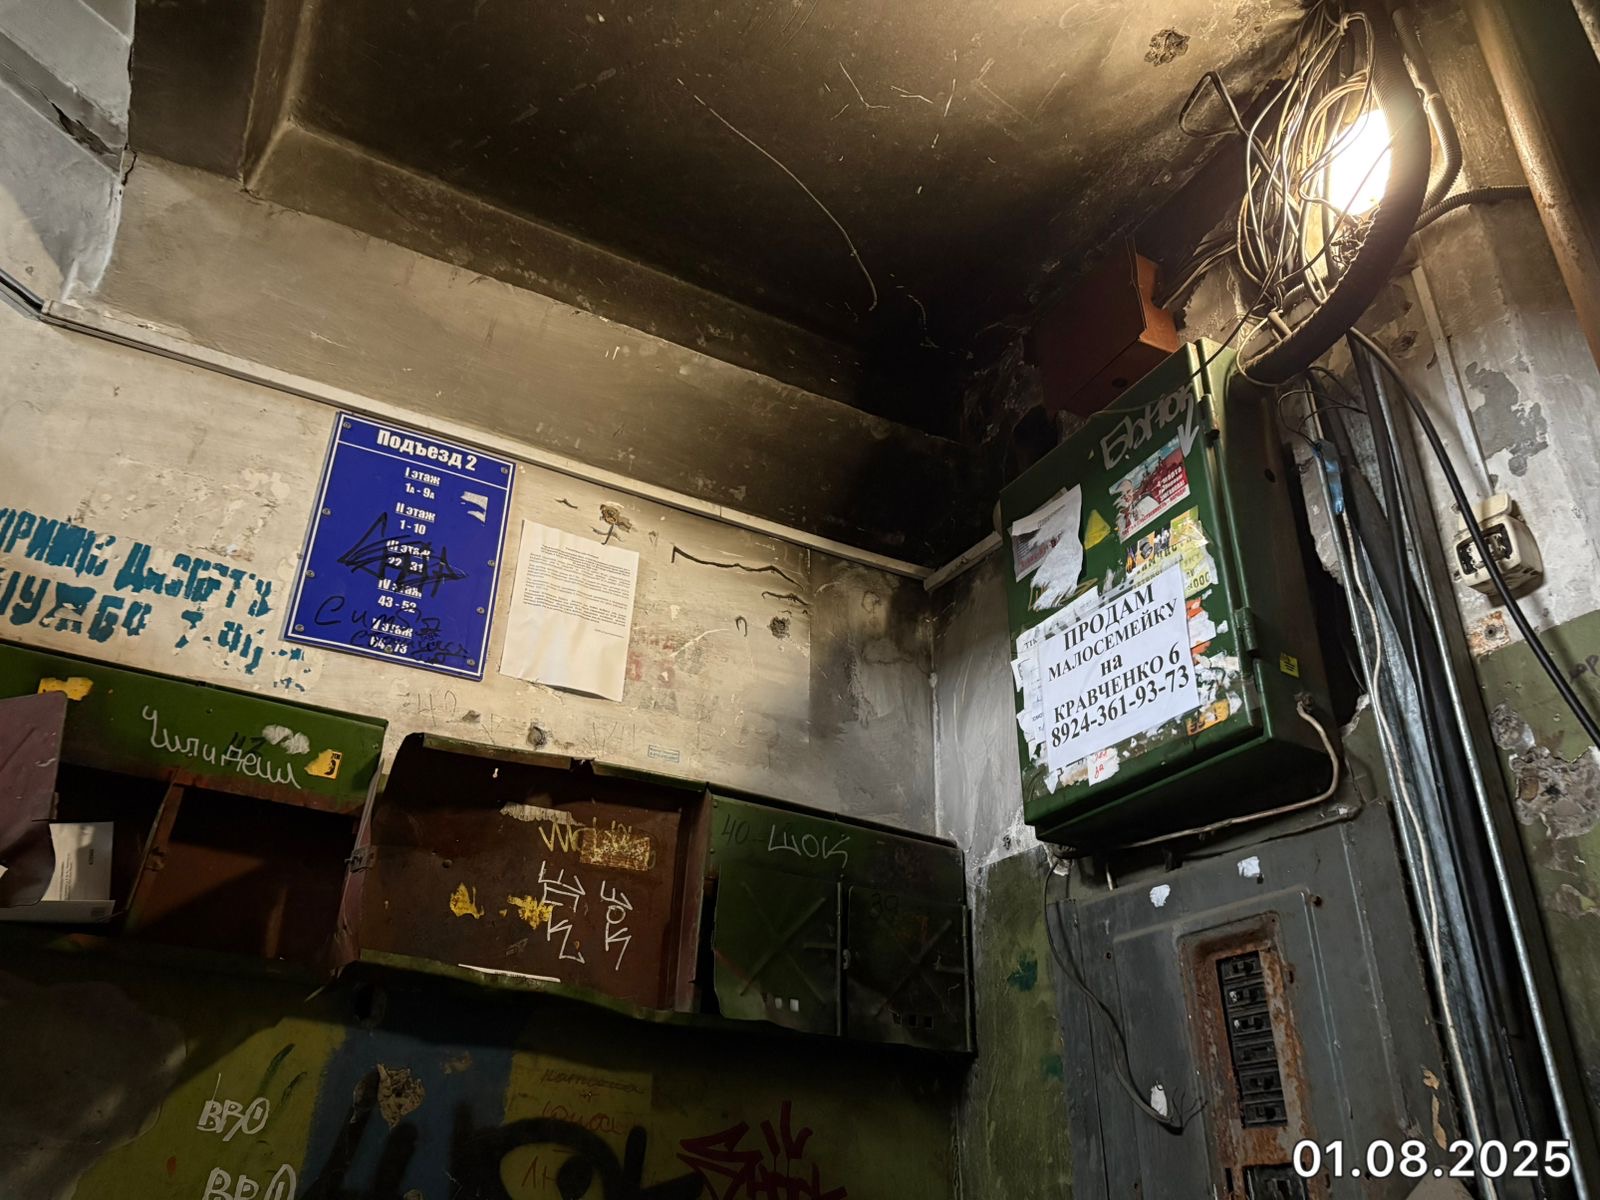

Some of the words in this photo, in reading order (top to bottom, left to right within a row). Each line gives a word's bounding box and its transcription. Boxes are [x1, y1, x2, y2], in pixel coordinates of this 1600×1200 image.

[376, 429, 462, 469] Подъезд
[465, 455, 478, 471] 2
[411, 469, 440, 486] этаж
[406, 505, 436, 522] этаж
[399, 519, 406, 530] 1
[413, 523, 427, 535] 10
[409, 561, 424, 572] 31
[377, 595, 393, 609] 43
[401, 600, 417, 614] 52
[1062, 583, 1155, 652] ПРОДАМ
[1047, 598, 1178, 682] МАЛОСЕМЕЙКУ
[1100, 654, 1124, 677] на
[1053, 655, 1165, 724] КРАВЧЕНКО
[1168, 641, 1181, 665] 6
[1051, 664, 1191, 748] 8924-361-93-73
